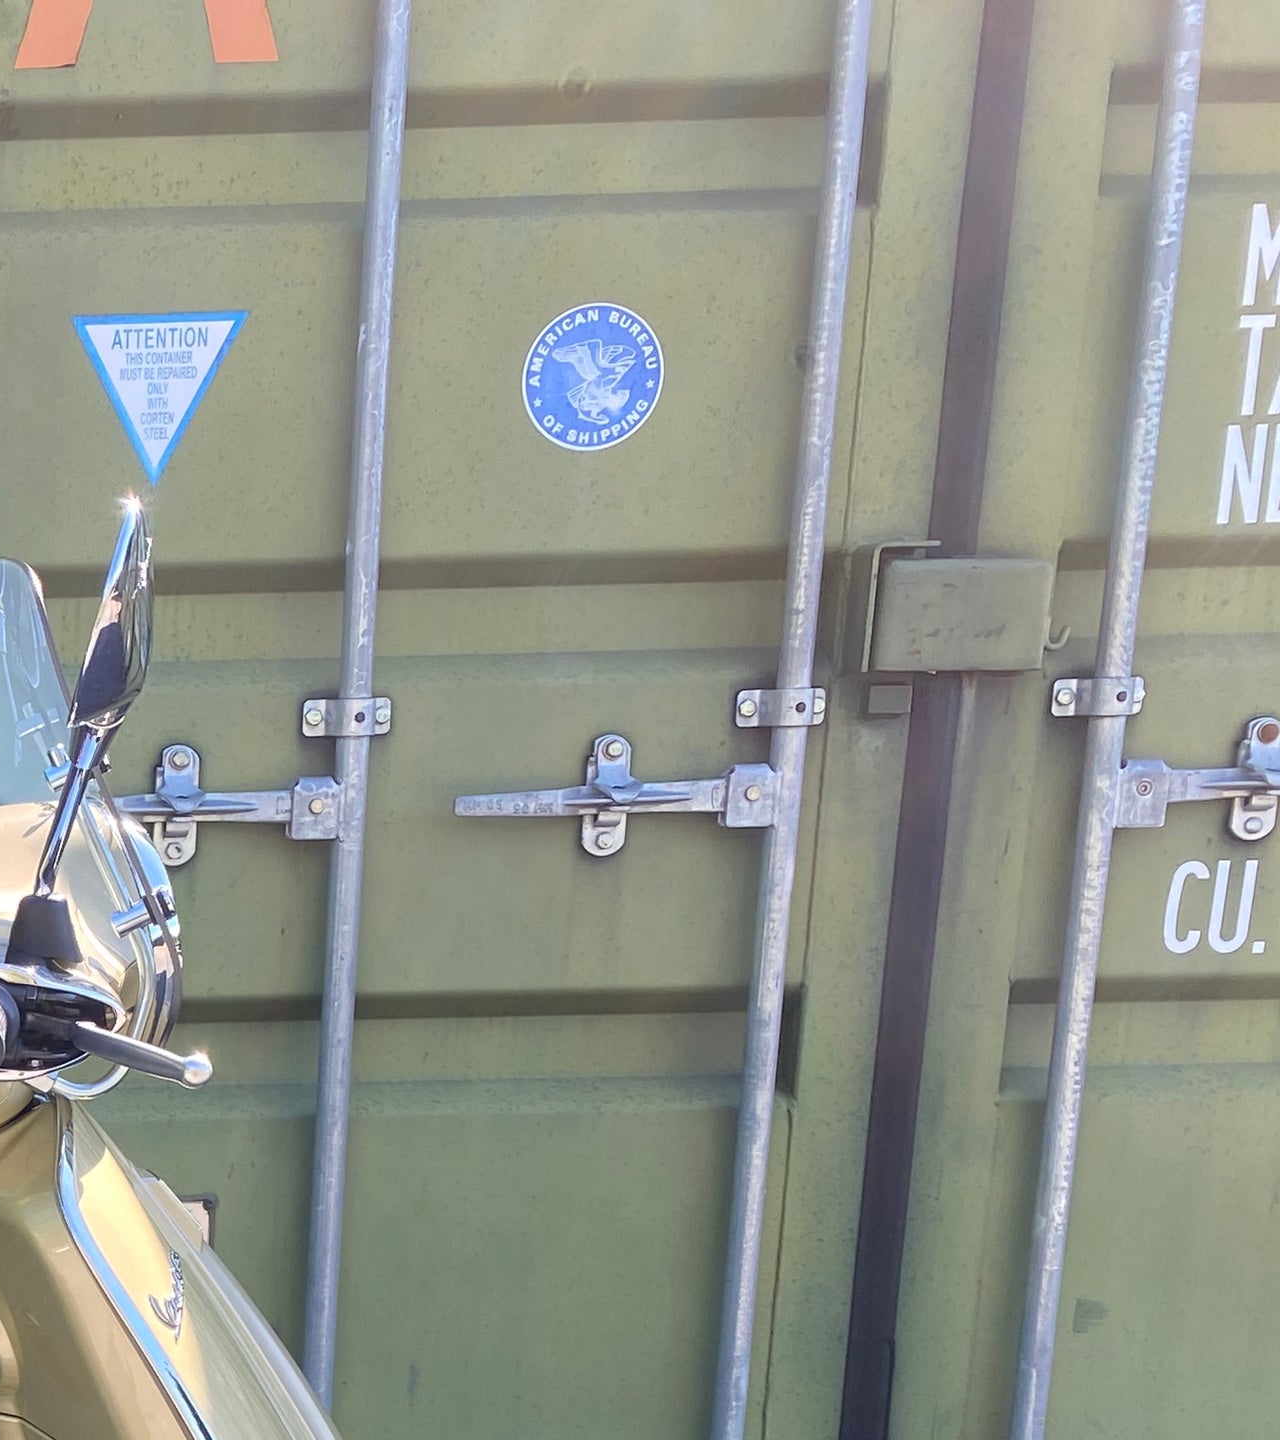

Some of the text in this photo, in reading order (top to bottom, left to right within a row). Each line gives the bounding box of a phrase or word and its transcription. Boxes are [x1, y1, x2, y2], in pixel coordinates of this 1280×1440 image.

[111, 327, 208, 350] ATTENTION
[529, 309, 658, 388] AMERICAN BUREAU
[125, 351, 193, 366] THIS CONTAINER
[1239, 314, 1280, 415] T
[120, 366, 198, 381] MUST BE REPAIRED
[147, 383, 169, 395] ONLY
[147, 397, 168, 409] WITH
[140, 412, 174, 425] CORTEN
[543, 399, 649, 444] OF SHIPPING
[143, 427, 169, 440] STEEL
